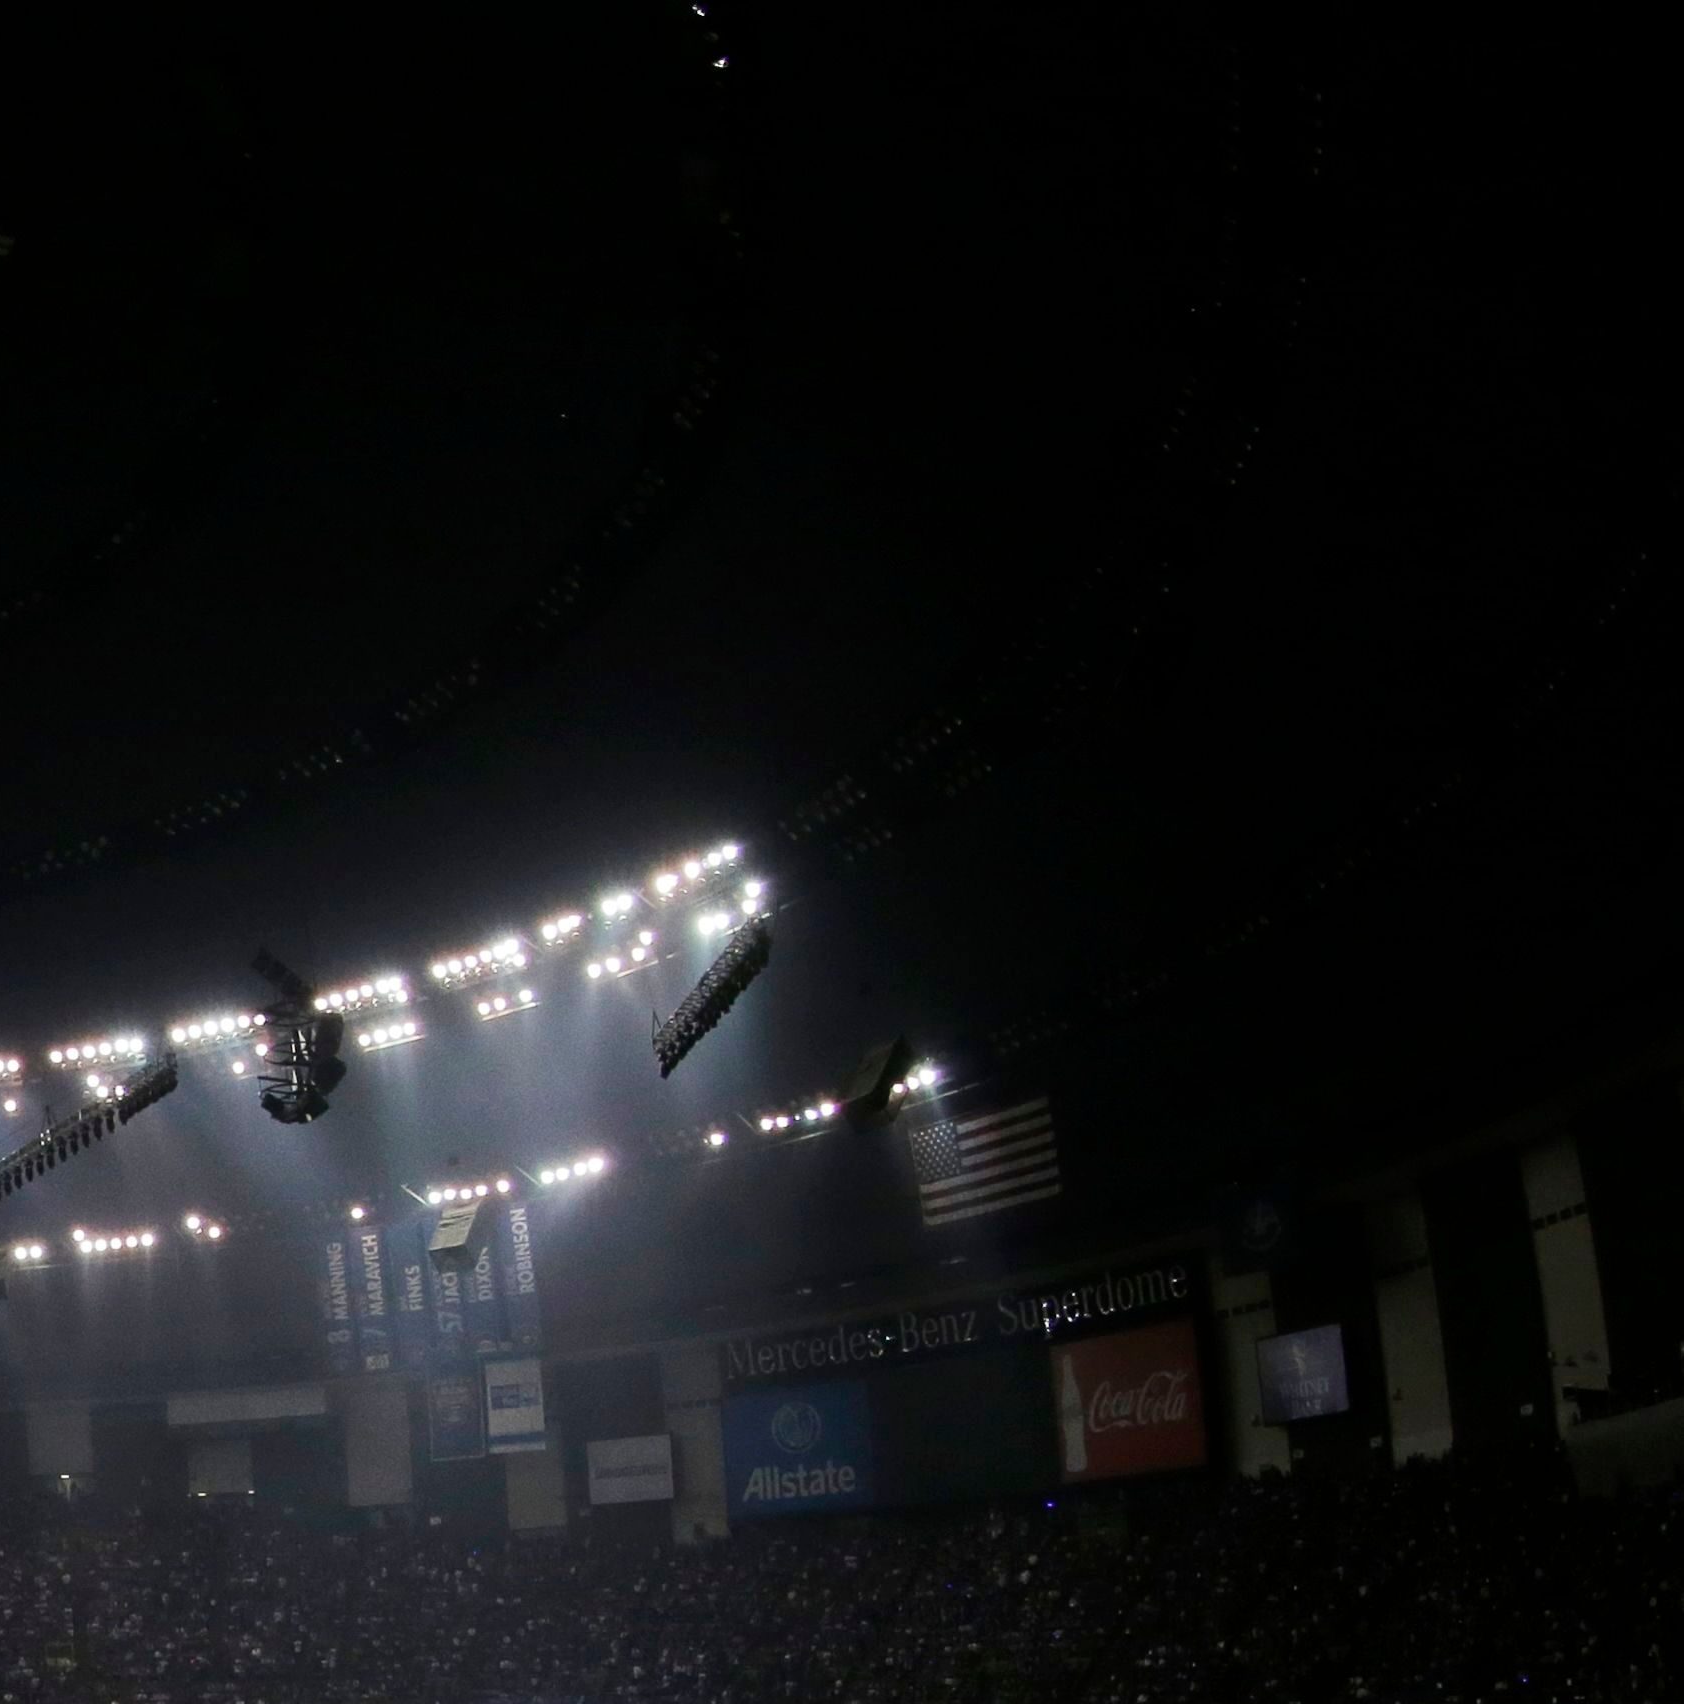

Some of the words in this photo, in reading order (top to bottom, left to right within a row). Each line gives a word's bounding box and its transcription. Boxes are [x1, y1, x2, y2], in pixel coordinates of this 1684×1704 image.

[327, 1242, 348, 1320] MANNING
[361, 1234, 385, 1316] MARAVICH
[405, 1264, 423, 1311] FINKS
[510, 1208, 535, 1294] ROBINSON
[728, 1309, 978, 1380] Mercedes-Benz
[997, 1263, 1189, 1340] Superdome
[743, 1461, 856, 1502] Allstate
